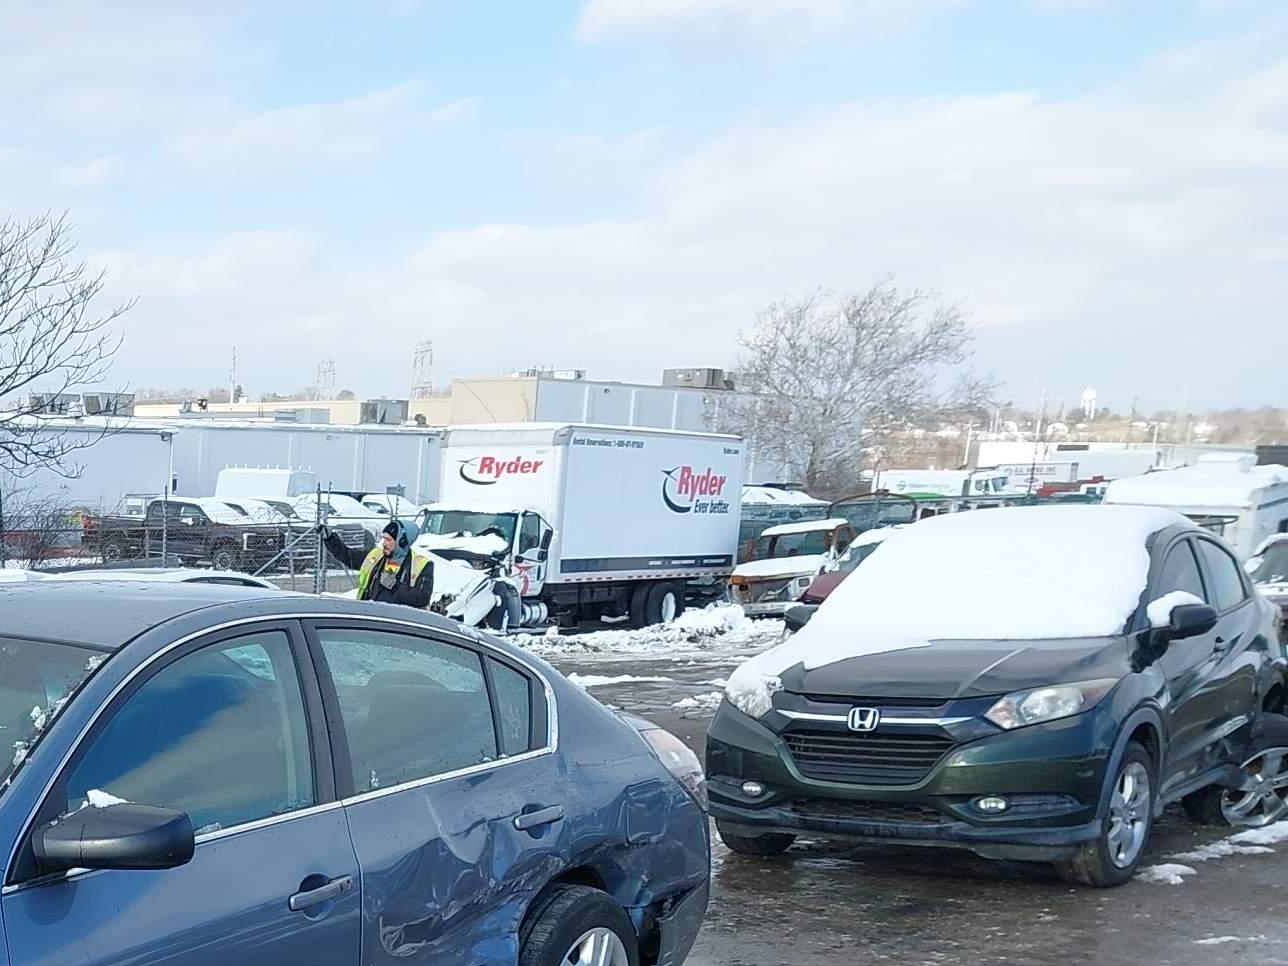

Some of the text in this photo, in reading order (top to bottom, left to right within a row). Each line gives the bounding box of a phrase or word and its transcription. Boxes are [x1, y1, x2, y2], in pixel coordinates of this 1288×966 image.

[478, 455, 544, 478] Ryder
[677, 465, 727, 502] Ryder
[694, 499, 710, 514] Ever
